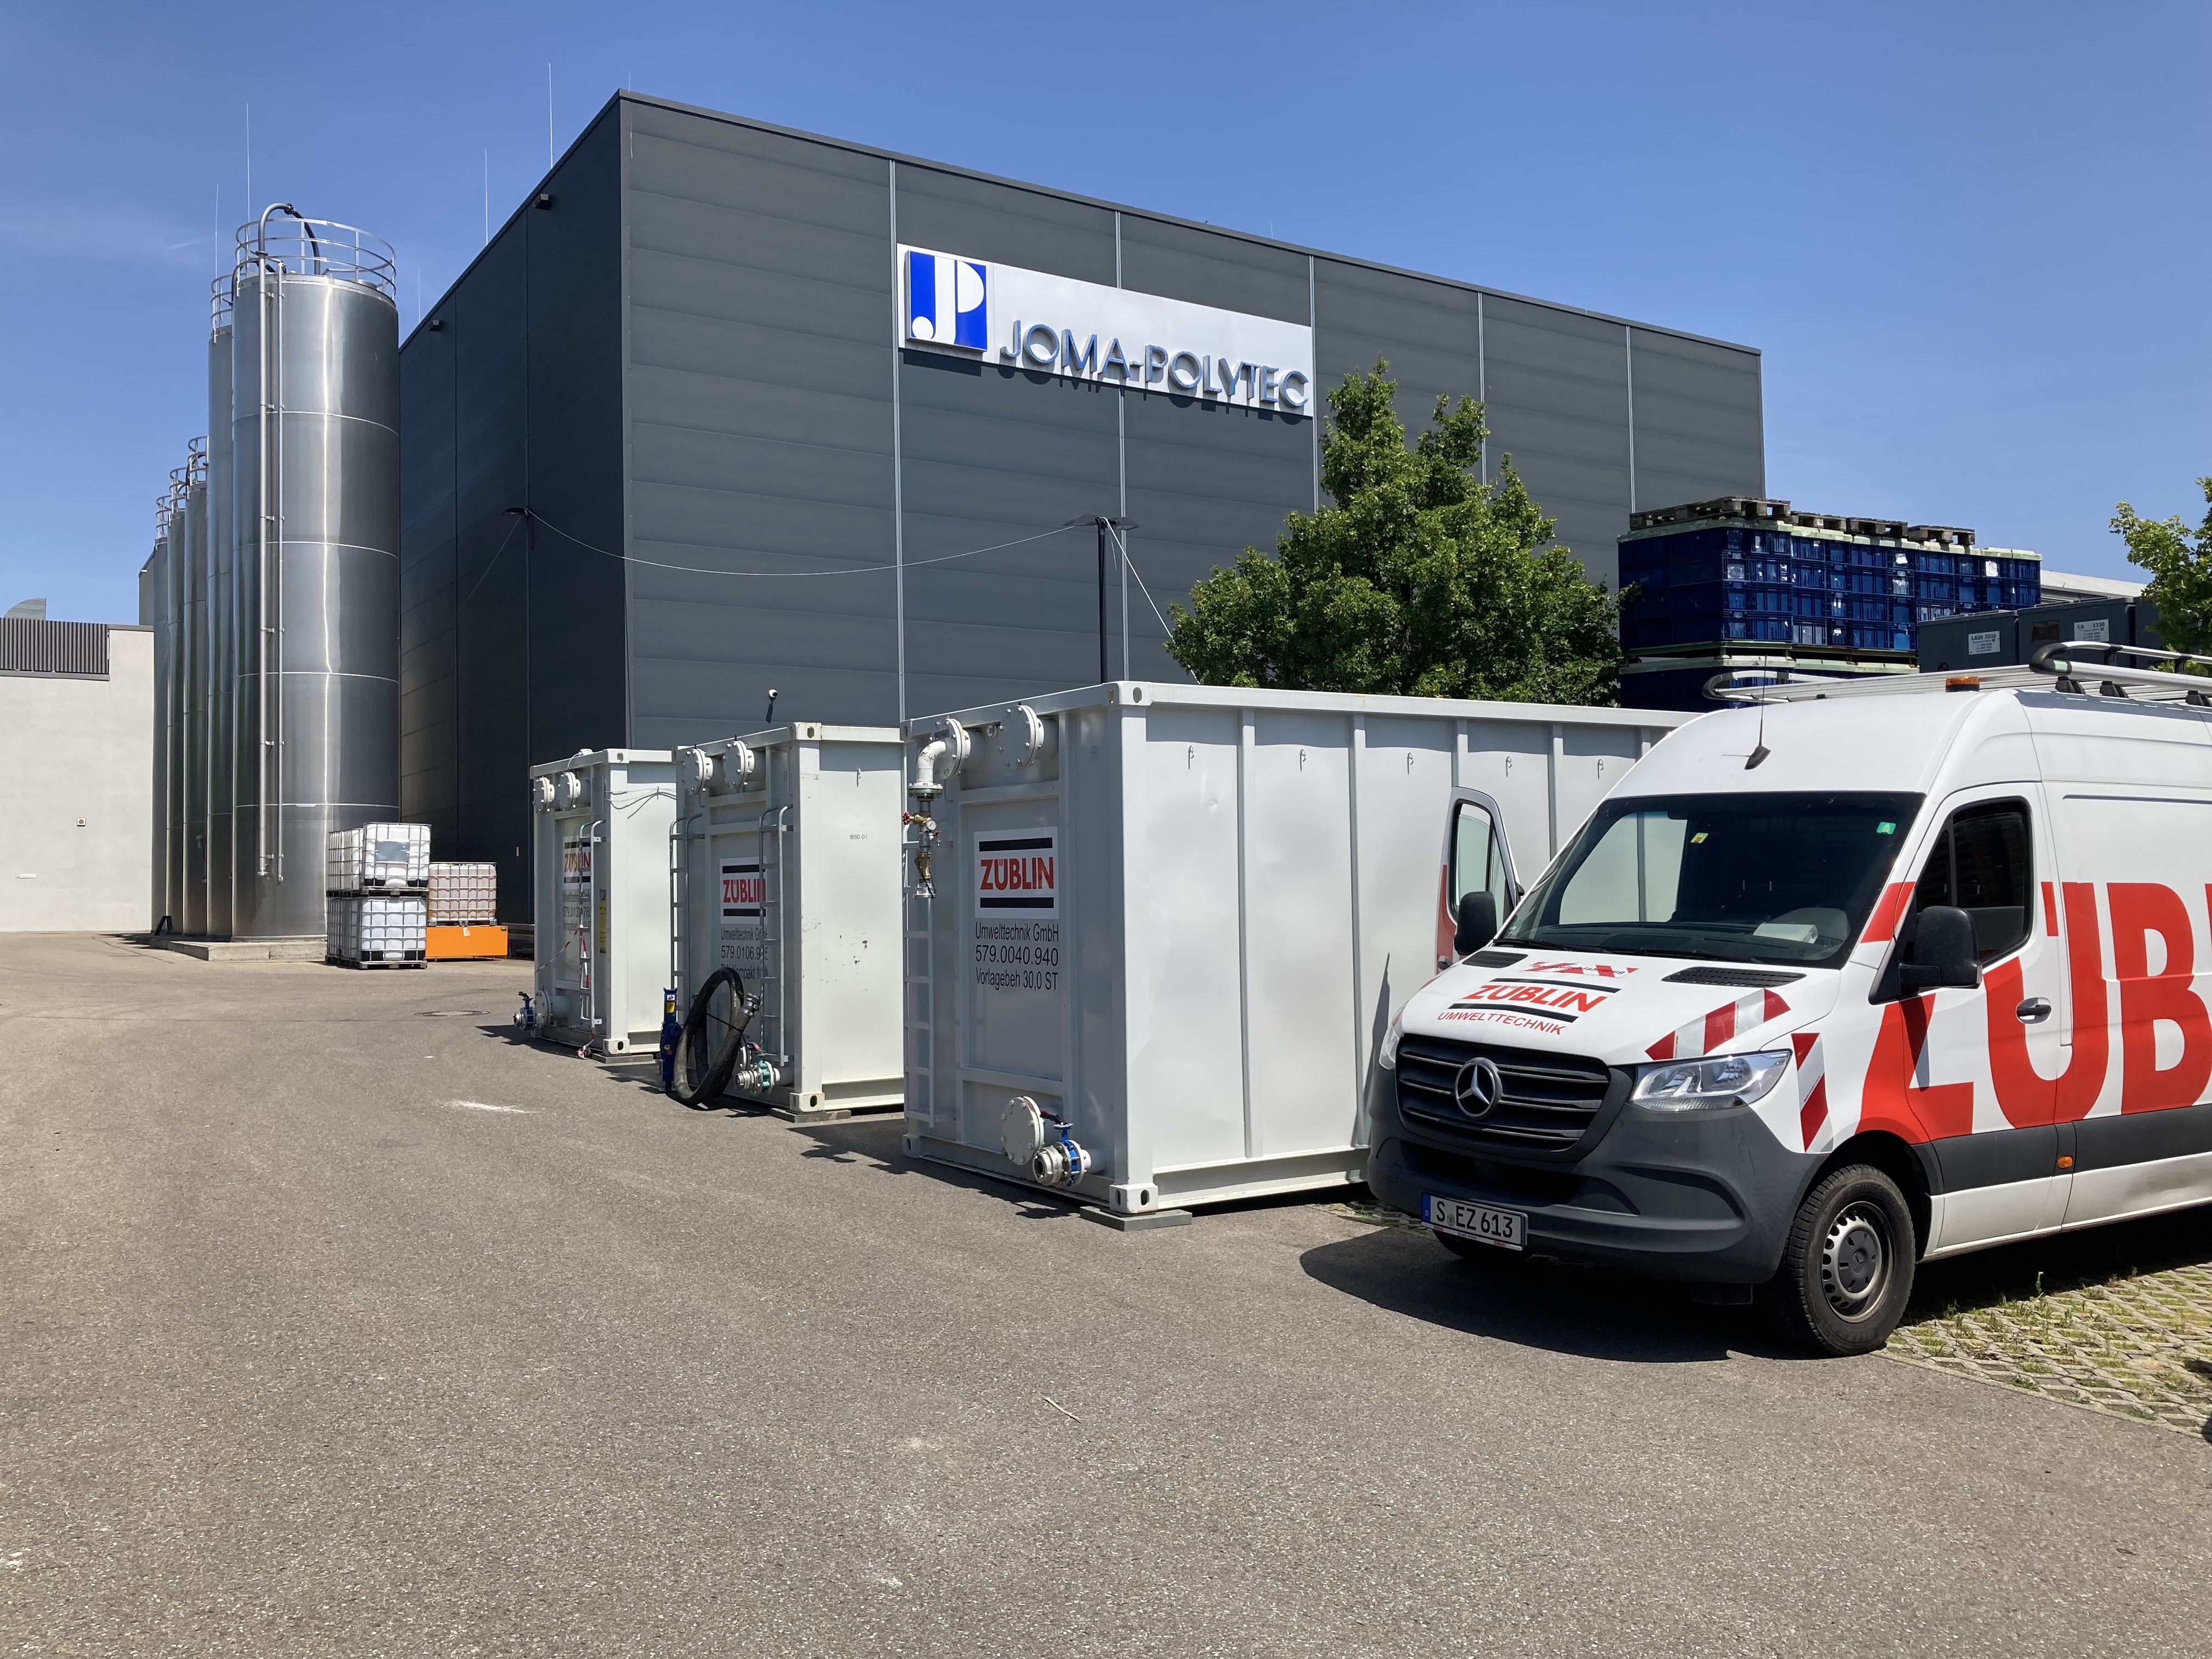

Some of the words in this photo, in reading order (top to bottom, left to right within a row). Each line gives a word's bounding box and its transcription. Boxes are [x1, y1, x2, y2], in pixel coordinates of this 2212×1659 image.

[1000, 320, 1309, 408] JOMA-POLYTEC
[980, 857, 1054, 890] ZÜBLIN
[975, 922, 1030, 941] Umwelttechnik
[1033, 923, 1059, 942] GmbH
[975, 945, 1059, 966] 579.0040.940
[975, 967, 1020, 991] Vorlagebeh
[1023, 970, 1042, 992] 30,0
[1045, 972, 1058, 991] ST
[1462, 985, 1608, 1012] ZÜBLIN
[1437, 1012, 1567, 1035] UMWELTTECHNIK
[1436, 1200, 1446, 1222] S
[1456, 1205, 1477, 1231] EZ
[1481, 1212, 1513, 1238] 613
